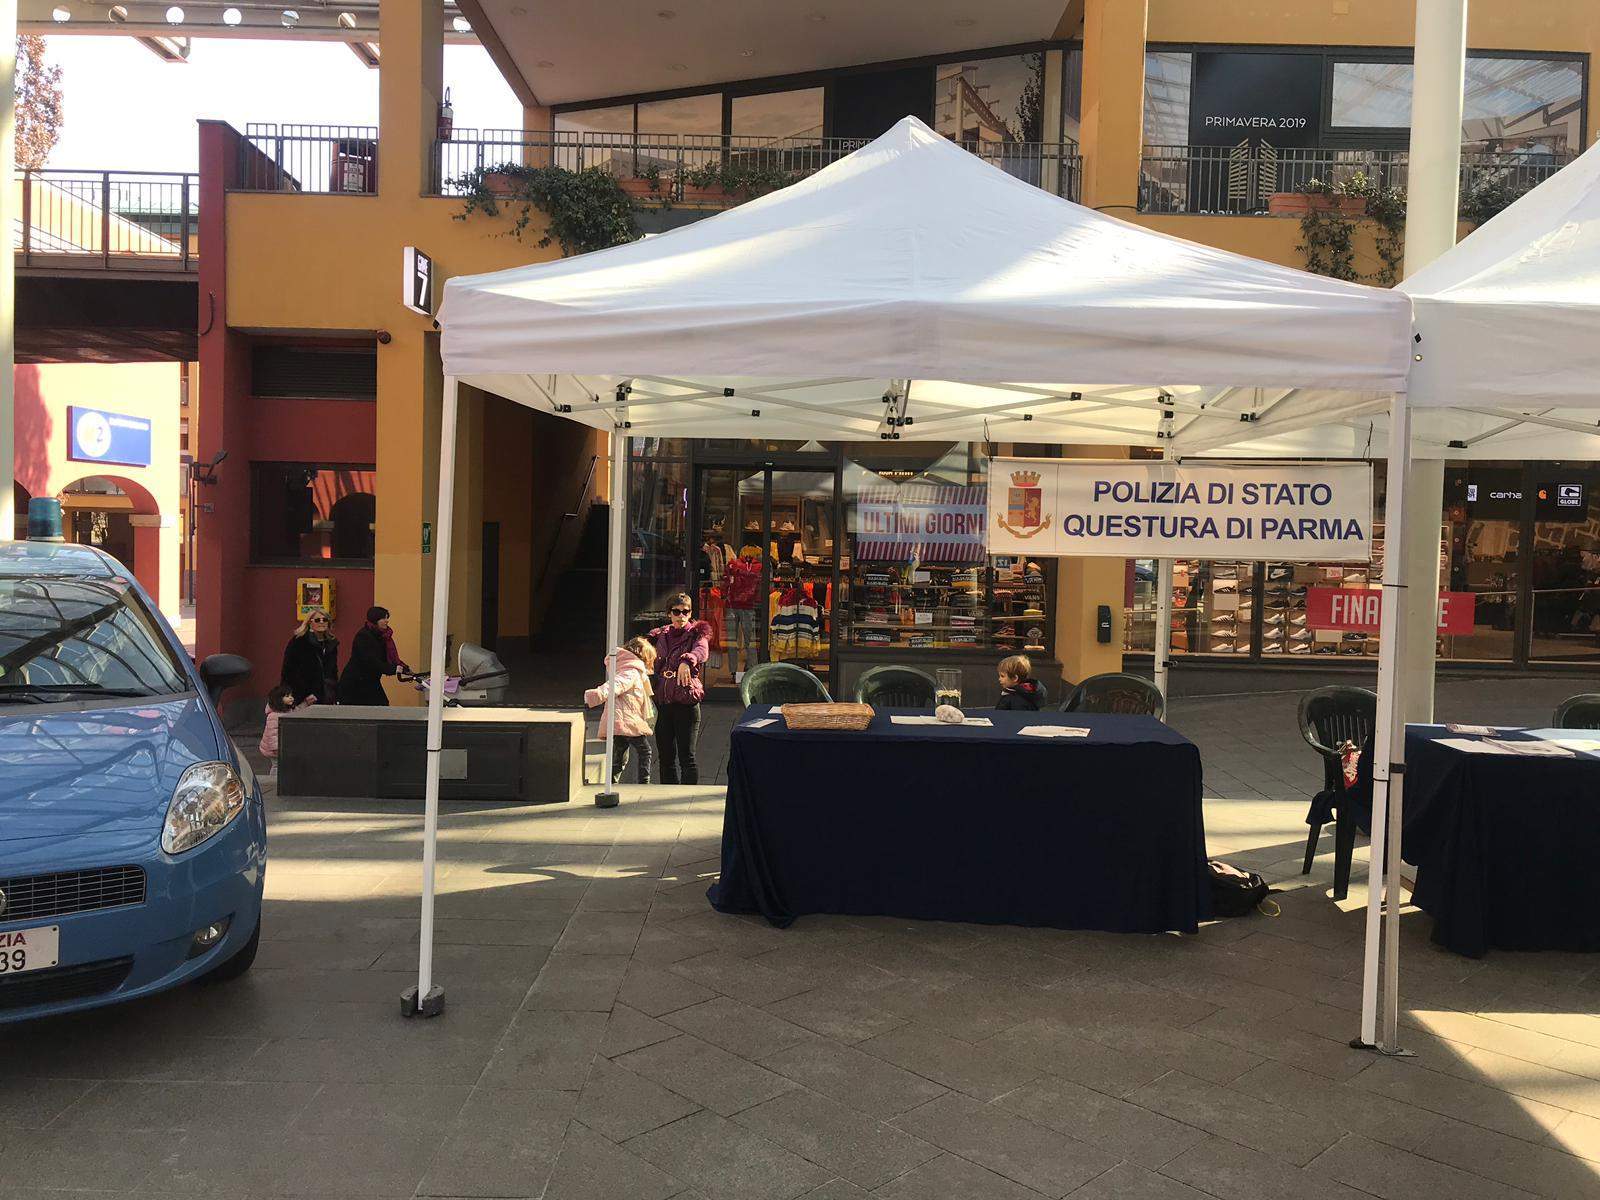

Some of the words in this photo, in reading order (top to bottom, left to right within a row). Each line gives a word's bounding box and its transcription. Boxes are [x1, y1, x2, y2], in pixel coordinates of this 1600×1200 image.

[1205, 116, 1277, 128] PRIMAVERA
[1279, 117, 1307, 128] 2019
[417, 271, 428, 307] 7
[1093, 481, 1201, 504] POLIZIA
[1208, 483, 1234, 505] DI
[1241, 483, 1332, 506] STATO
[863, 511, 920, 534] ULTIMI
[925, 512, 984, 535] GIORNI
[1063, 514, 1220, 539] QUESTURA
[1226, 517, 1252, 540] DI
[1261, 518, 1364, 541] PARMA
[1331, 594, 1379, 625] FINA
